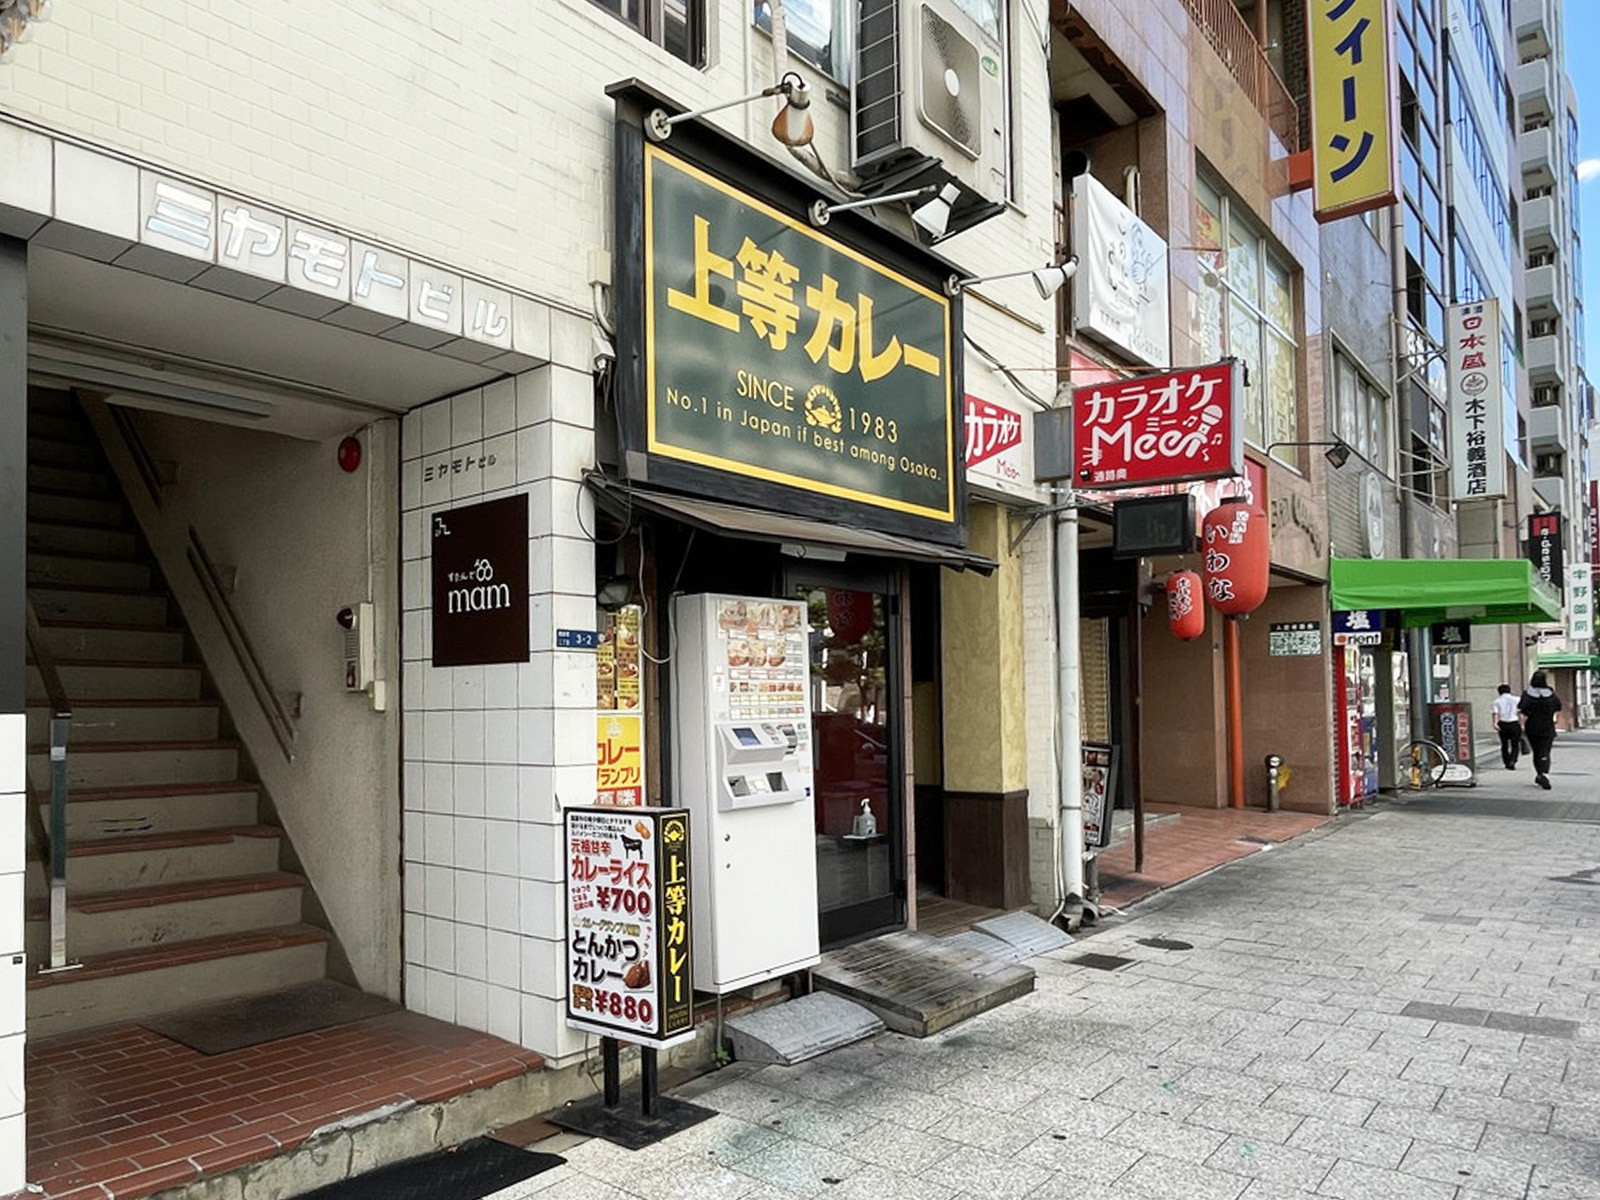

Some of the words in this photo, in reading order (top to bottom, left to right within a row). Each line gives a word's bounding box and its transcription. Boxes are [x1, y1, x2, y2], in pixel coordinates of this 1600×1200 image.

[146, 181, 508, 338] ミヤモトビル
[667, 214, 940, 383] 上等カレー
[1459, 316, 1487, 371] 日本盛
[737, 369, 794, 412] SINCE
[848, 407, 898, 444] 1983
[1082, 374, 1223, 426] カラオケ
[666, 387, 708, 414] No.1
[717, 401, 732, 422] in
[740, 410, 791, 440] Japan
[813, 431, 845, 454] best
[849, 444, 895, 473] among
[964, 402, 1020, 463] カラオケ
[423, 454, 497, 482] ミヤモトビル
[1204, 524, 1235, 602] いわな
[448, 583, 511, 614] mam
[1346, 611, 1371, 630] 塩
[597, 767, 640, 786] ランプリ
[571, 855, 653, 890] カレーライス
[596, 885, 652, 917] ¥700
[572, 929, 640, 962] とんかつ
[665, 854, 687, 1003] 上等カレー
[572, 956, 623, 984] カレー
[595, 988, 653, 1026] ¥880
